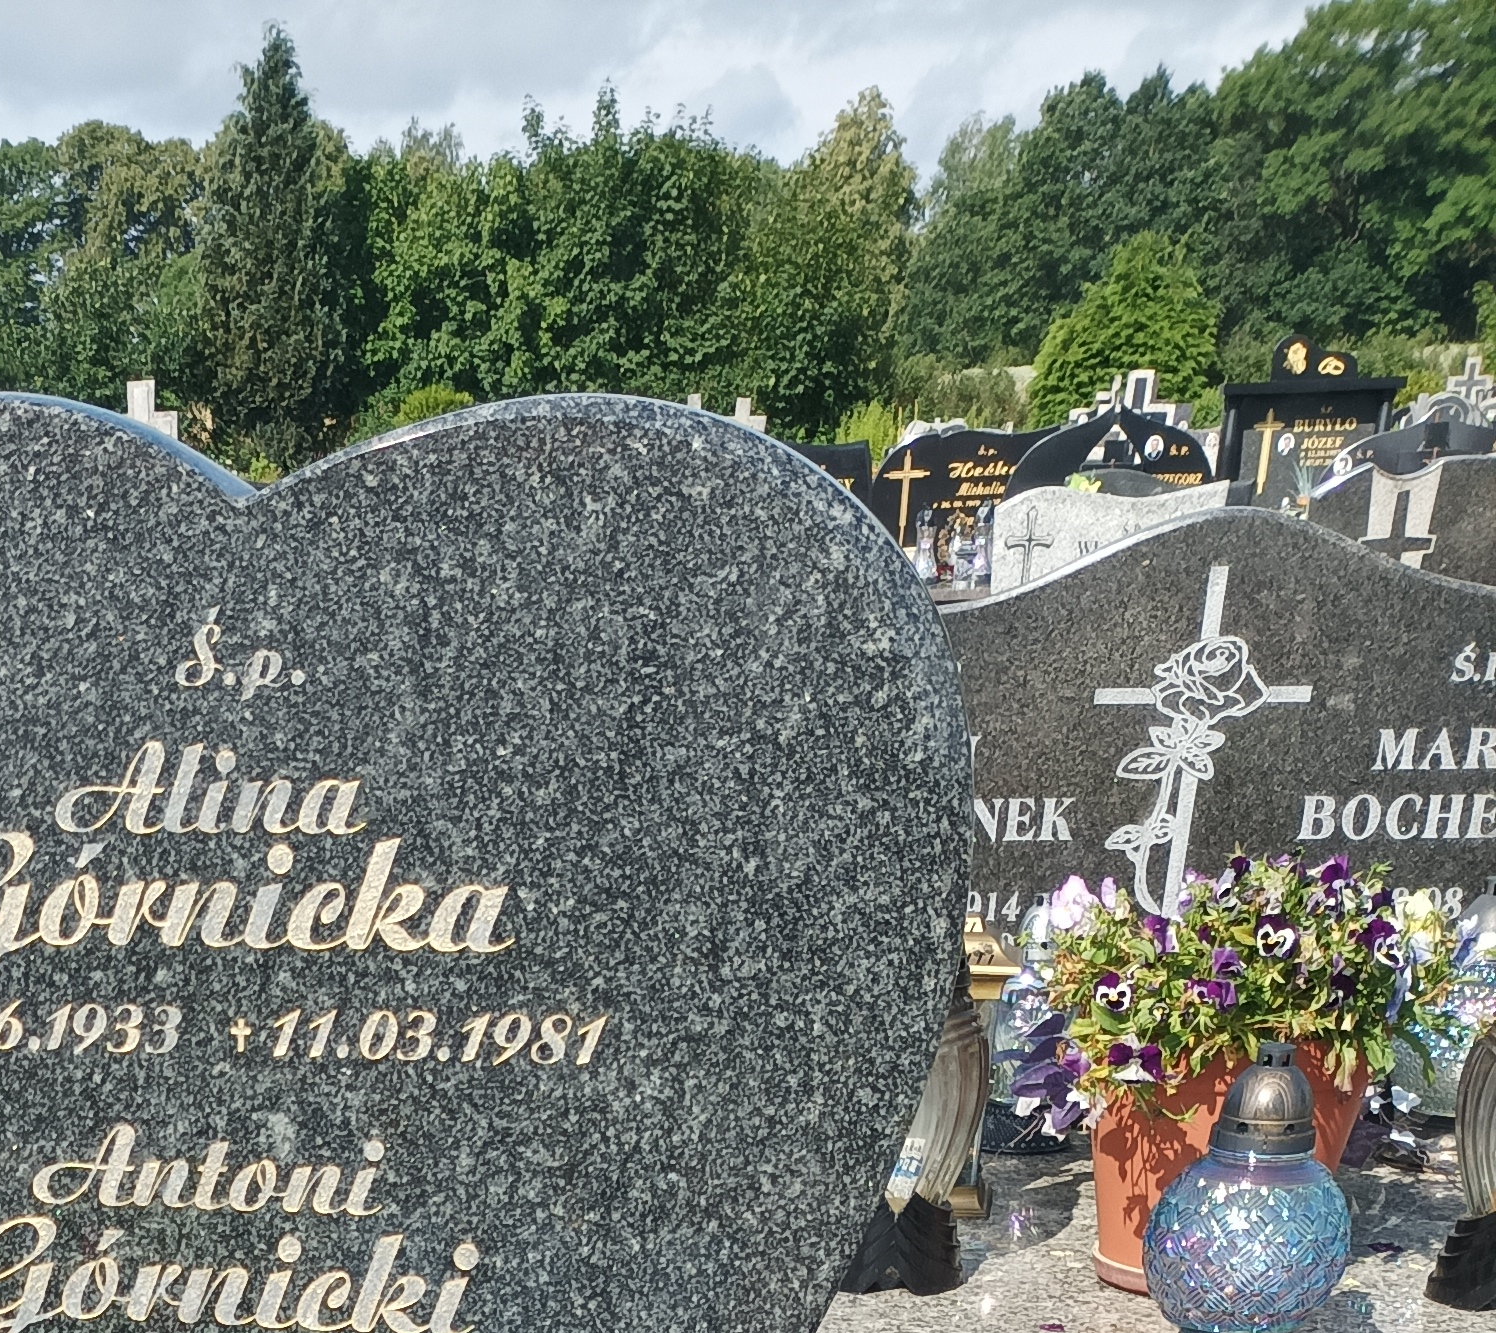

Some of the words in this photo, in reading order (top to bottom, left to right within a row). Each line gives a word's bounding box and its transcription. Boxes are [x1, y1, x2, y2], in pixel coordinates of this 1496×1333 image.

[1300, 435, 1344, 449] JÓZEF
[955, 481, 1006, 497] Michalin
[54, 739, 368, 837] Alina
[270, 1007, 609, 1067] 11.03.1981
[31, 1122, 387, 1219] Antoni
